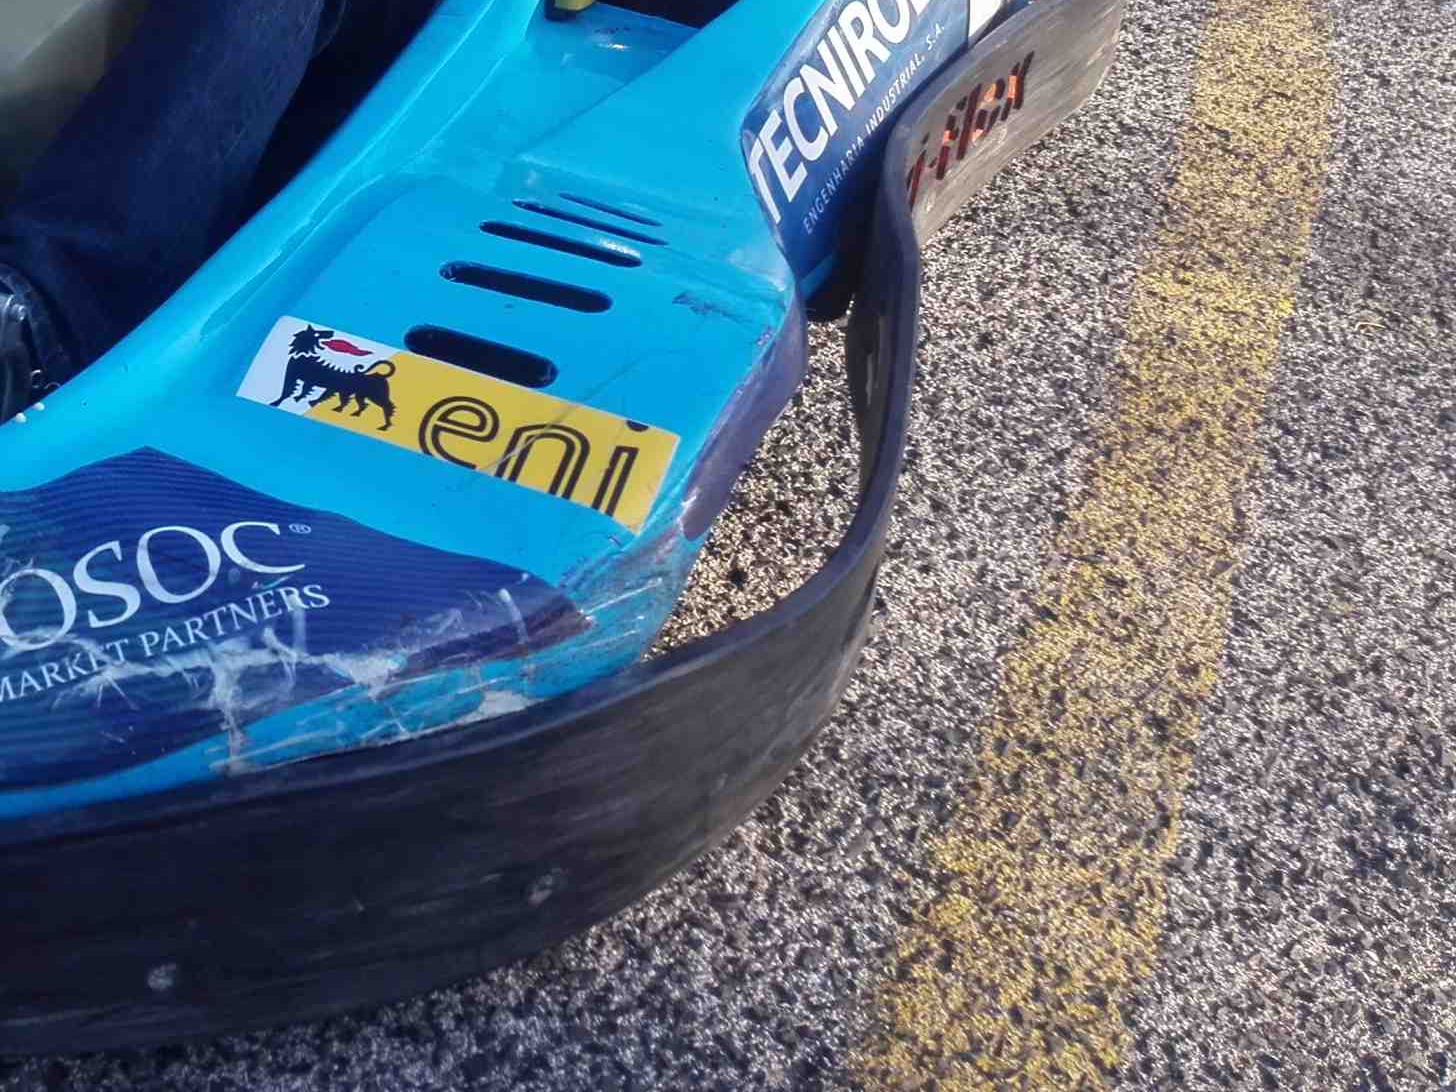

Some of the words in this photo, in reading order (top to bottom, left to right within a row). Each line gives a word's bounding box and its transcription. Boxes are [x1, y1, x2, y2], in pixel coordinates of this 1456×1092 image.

[802, 135, 865, 235] ENGENHARIA
[417, 395, 650, 517] eni
[139, 583, 332, 661] PARTNERS
